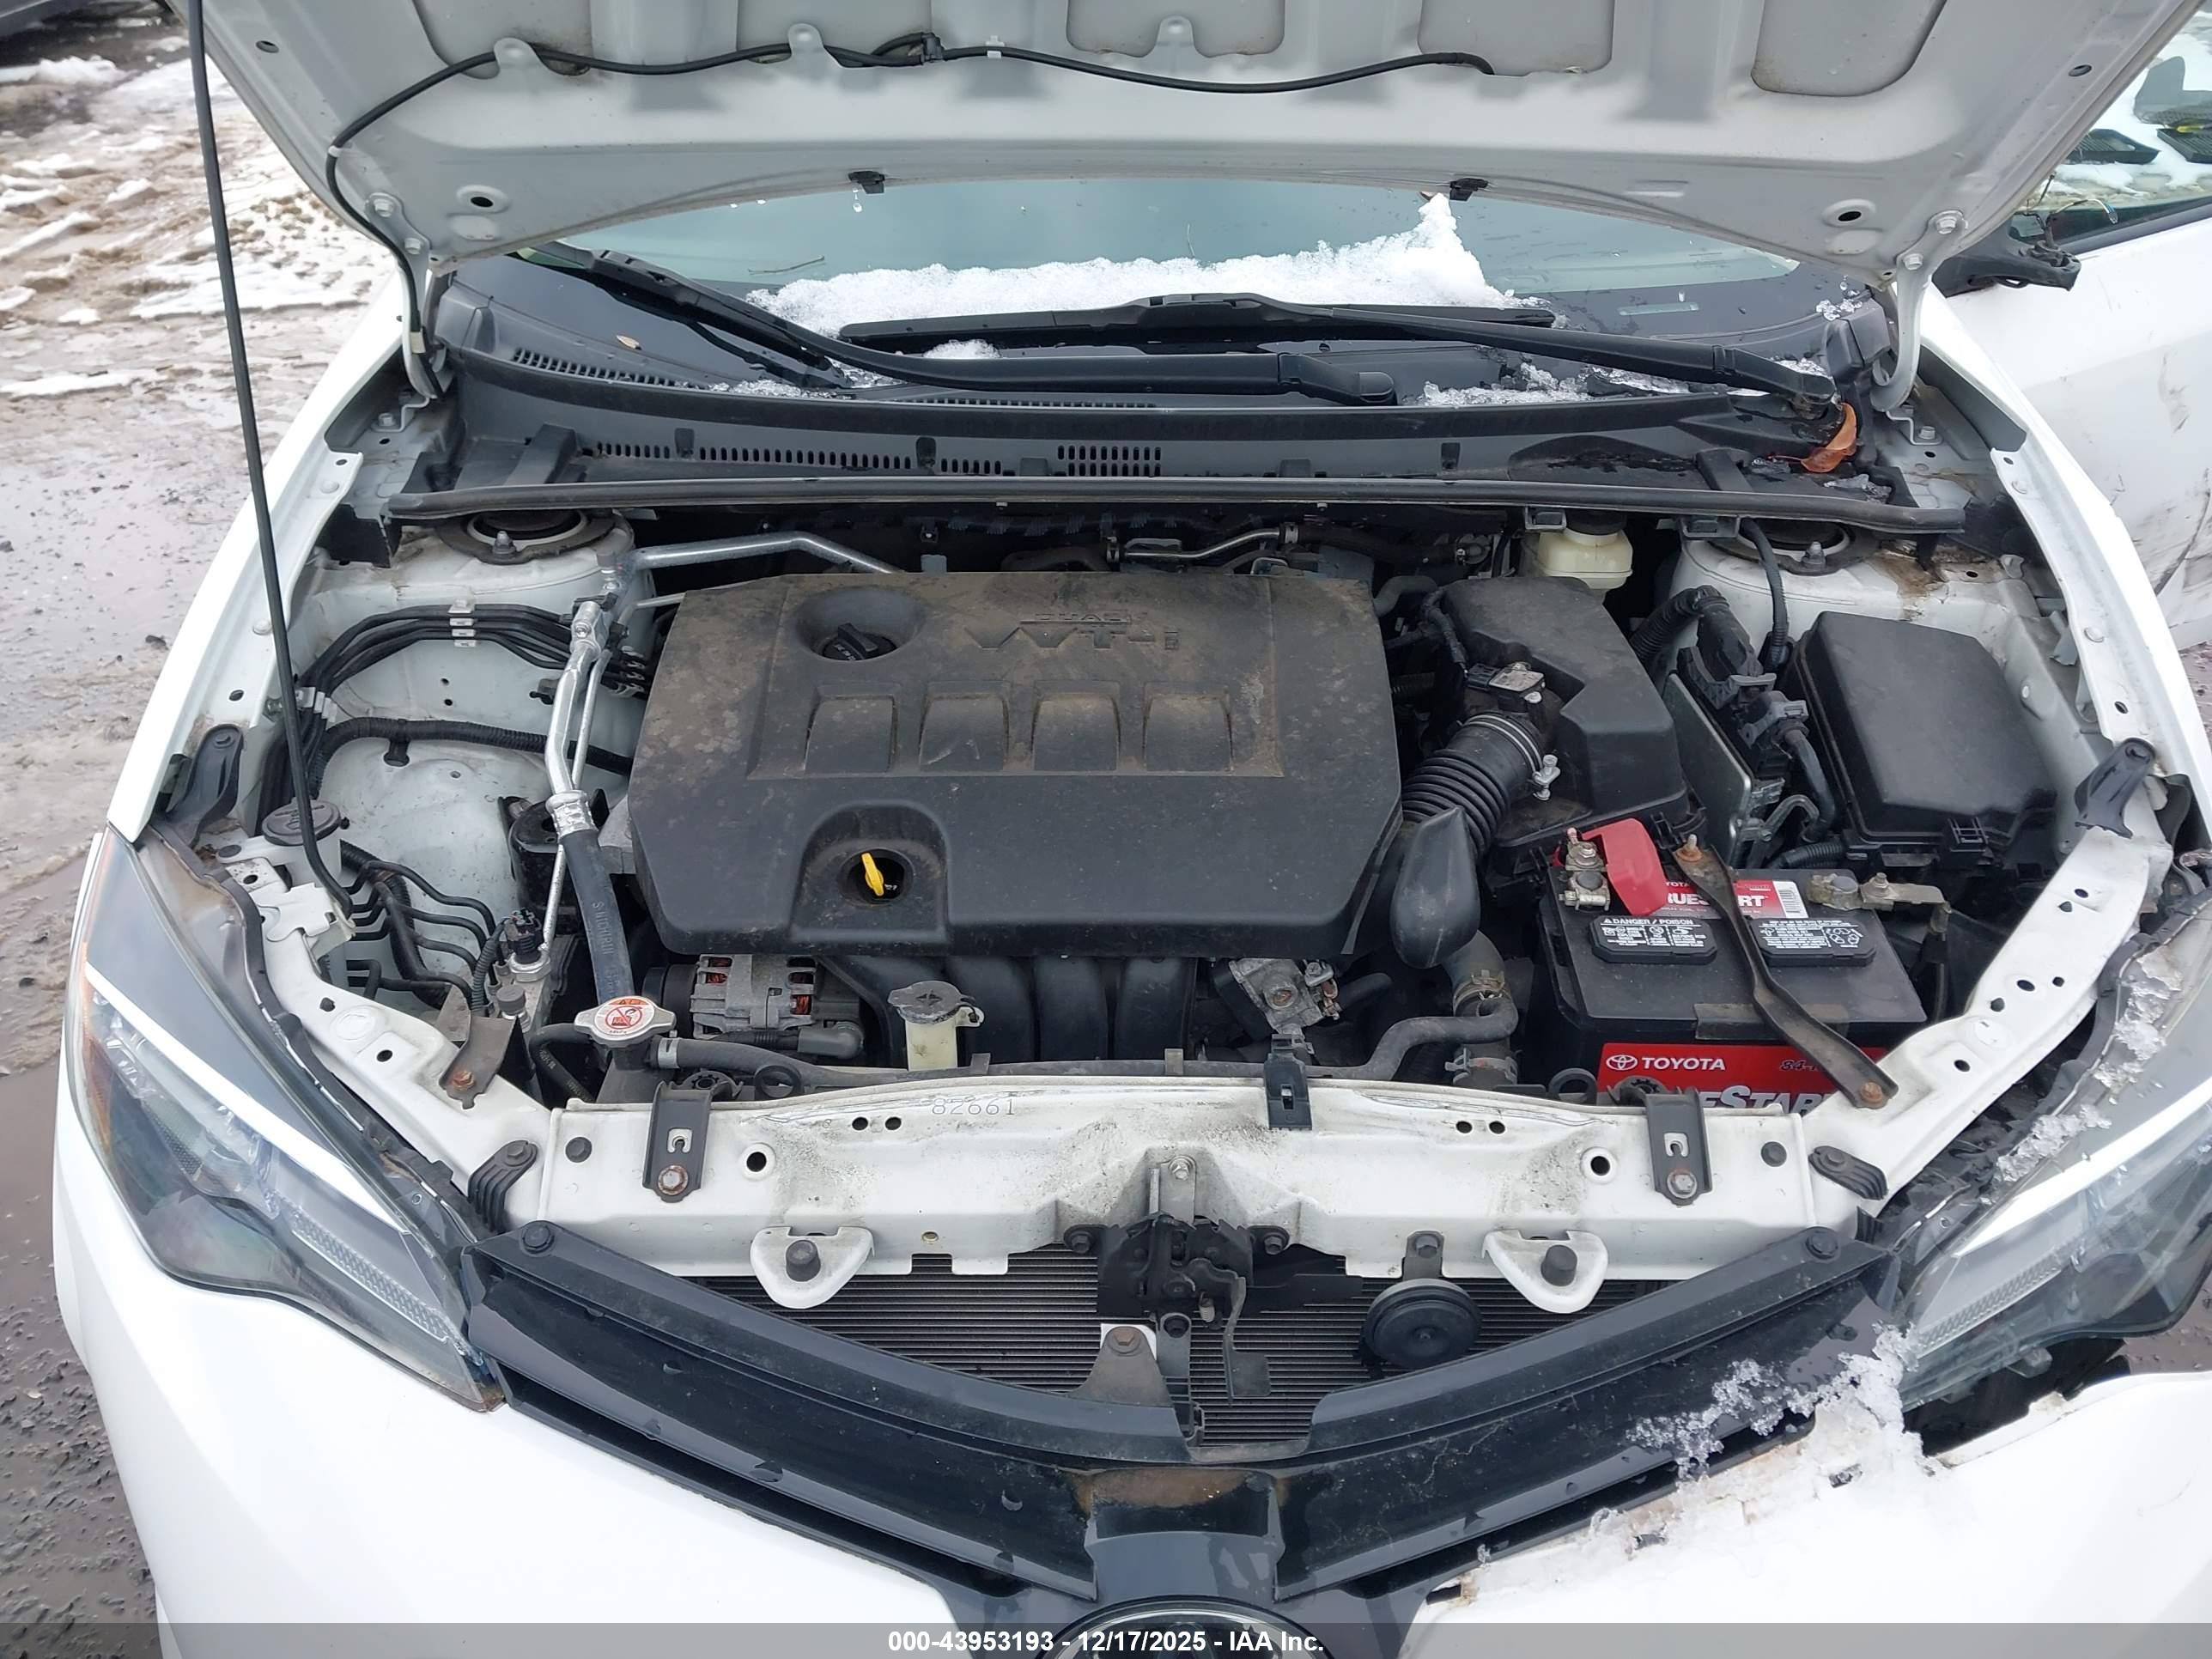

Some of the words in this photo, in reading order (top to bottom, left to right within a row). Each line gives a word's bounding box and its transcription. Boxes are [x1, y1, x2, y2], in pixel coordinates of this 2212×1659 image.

[1641, 1057, 1726, 1071] TOYOTA
[1779, 1059, 1819, 1072] 84-
[931, 1097, 1016, 1115] 82661
